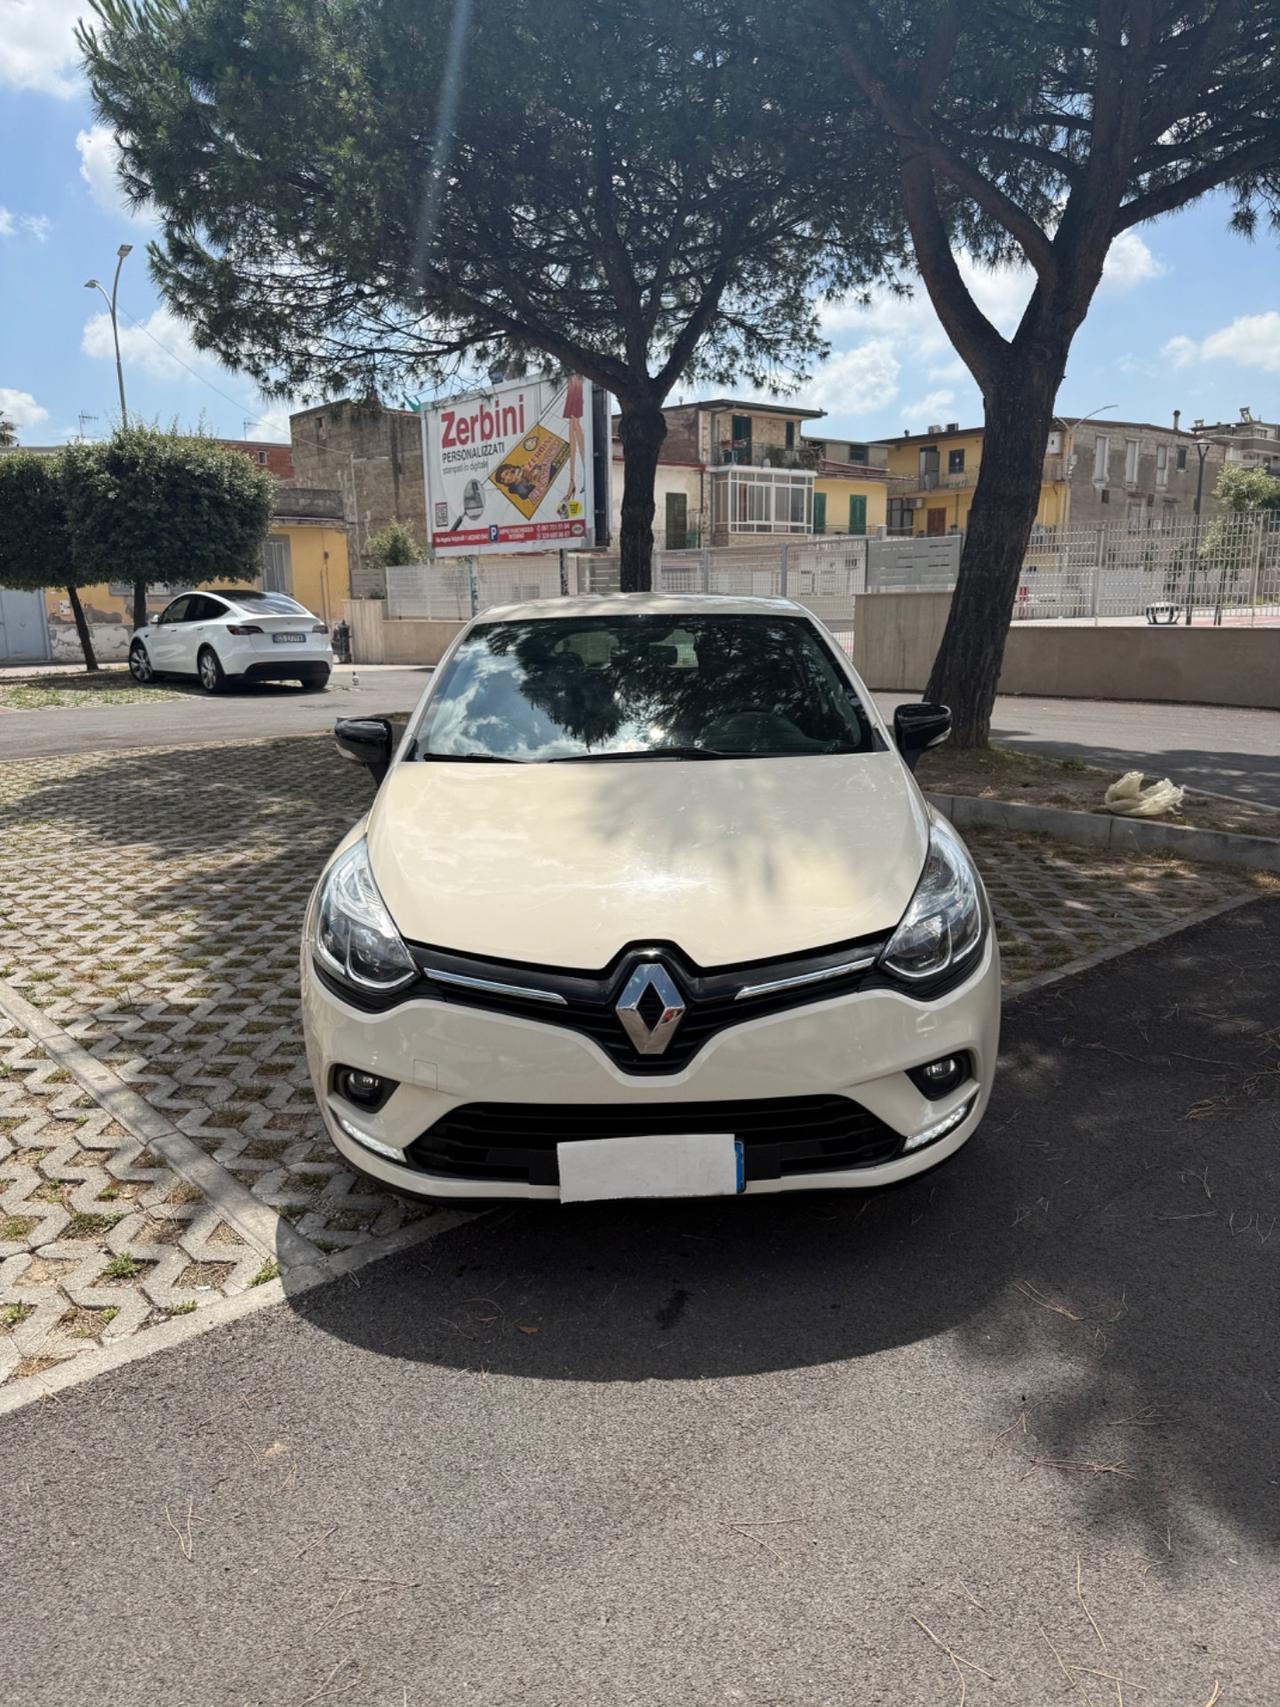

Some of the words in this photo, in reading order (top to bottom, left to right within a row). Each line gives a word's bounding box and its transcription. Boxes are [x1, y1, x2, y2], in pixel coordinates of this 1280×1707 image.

[441, 394, 525, 449] Zerbini
[442, 441, 505, 463] PERSONALIZZATI
[491, 526, 497, 540] P
